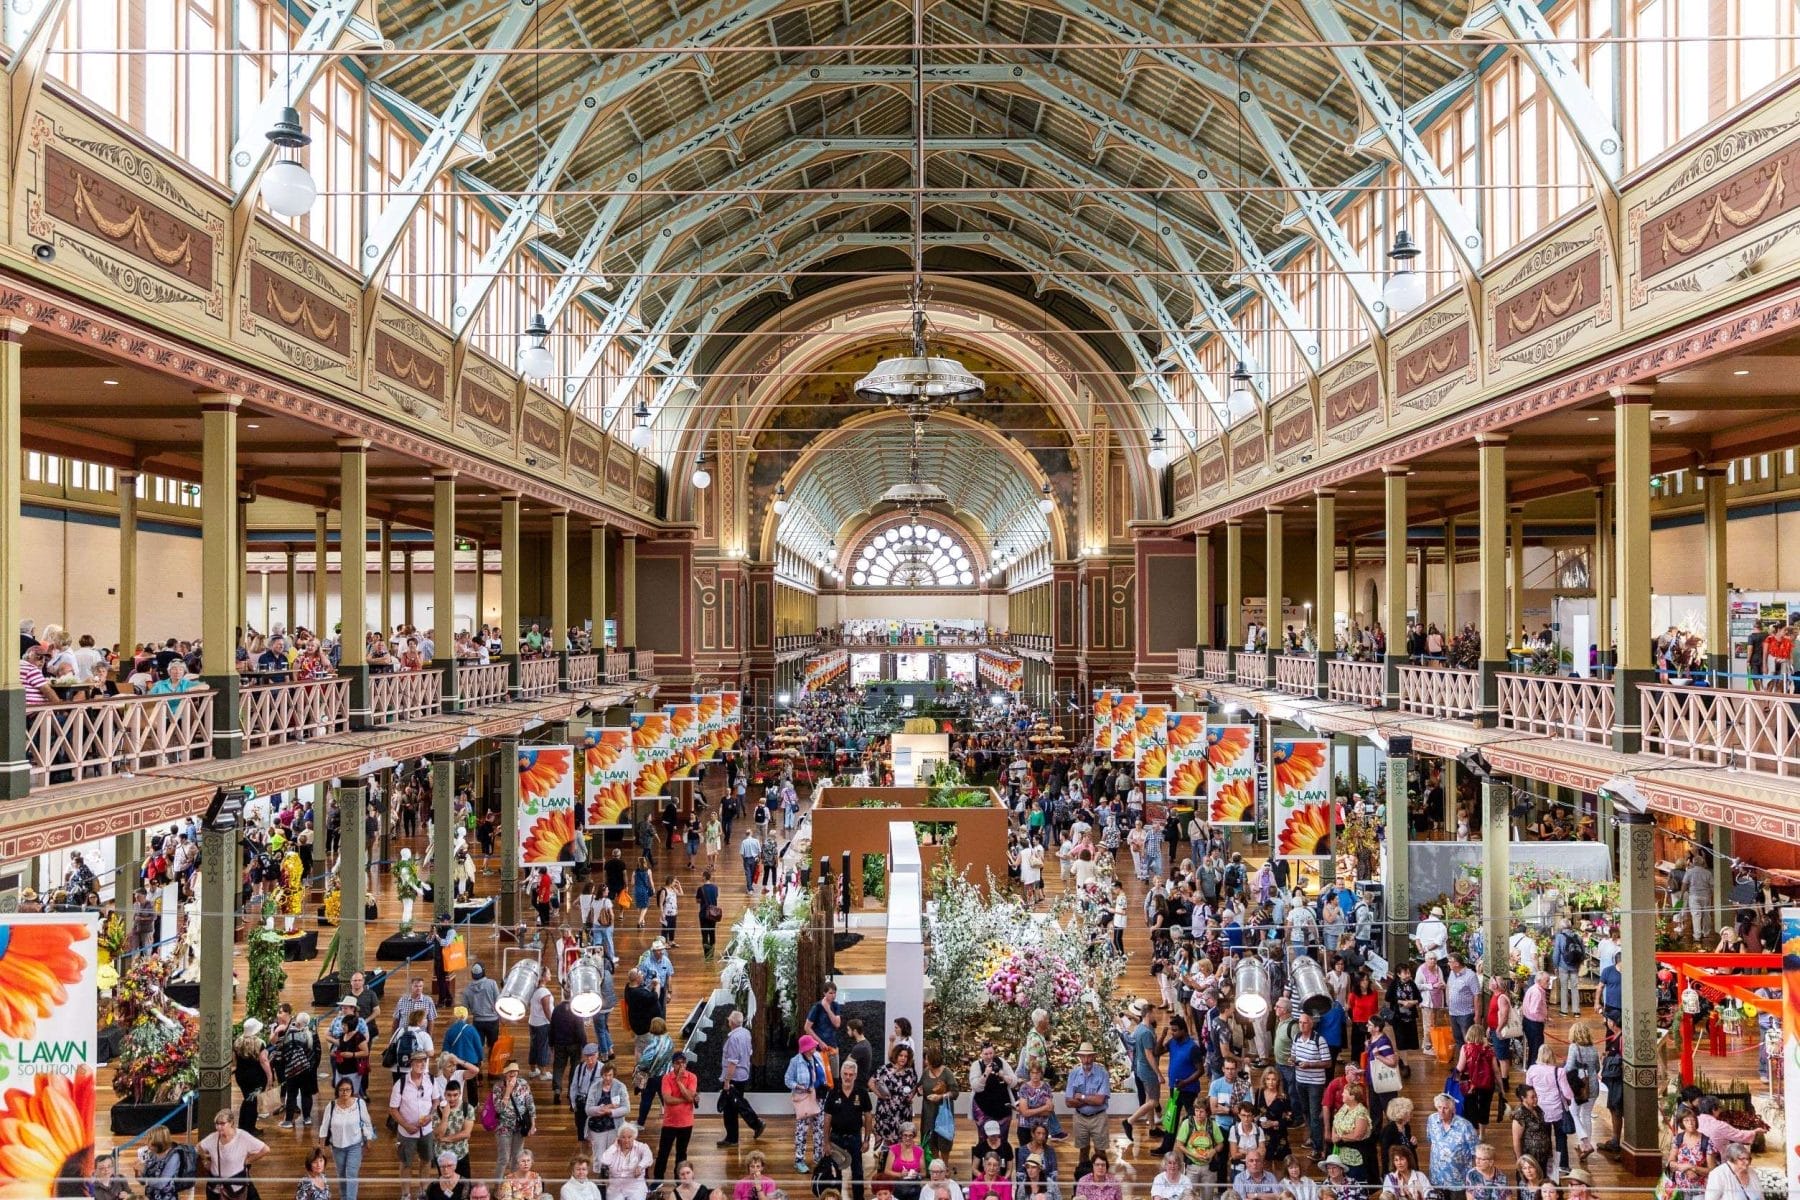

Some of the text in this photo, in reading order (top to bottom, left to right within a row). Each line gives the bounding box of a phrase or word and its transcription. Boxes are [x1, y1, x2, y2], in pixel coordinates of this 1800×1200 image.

[604, 771, 628, 780] LAWN
[1228, 768, 1251, 776] LAWN
[1298, 790, 1327, 800] LAWN
[542, 797, 570, 807] LAWN
[19, 1041, 86, 1063] LAWN
[18, 1064, 87, 1076] SOLUTIONS
